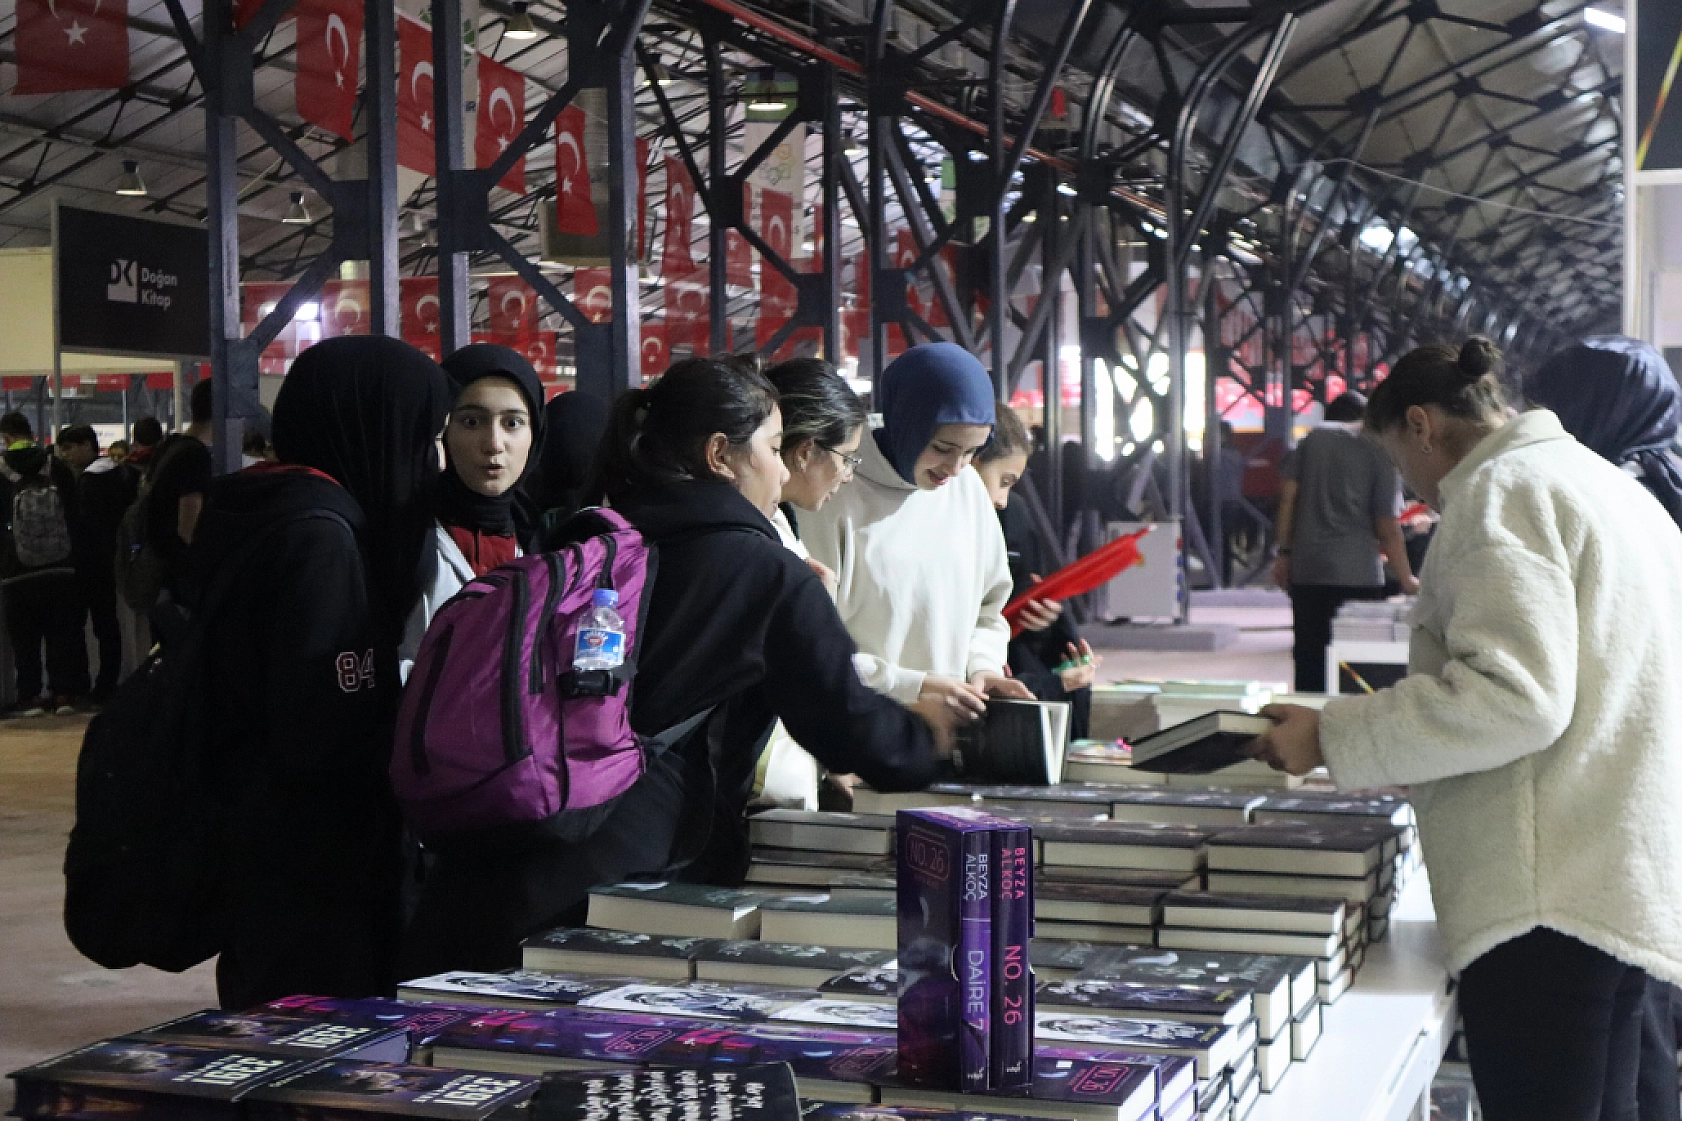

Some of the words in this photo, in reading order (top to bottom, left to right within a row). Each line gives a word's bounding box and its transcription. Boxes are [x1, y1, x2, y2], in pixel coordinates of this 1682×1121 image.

[141, 267, 178, 289] Doğan
[141, 289, 171, 311] Kitap
[335, 648, 375, 692] 84
[963, 853, 977, 901] ALKOÇ
[978, 854, 988, 900] BEYZA
[1000, 847, 1013, 900] ALKOÇ
[1014, 847, 1026, 900] BEYZA
[1004, 945, 1022, 986] NO.
[968, 1017, 984, 1030] 7
[1004, 995, 1022, 1025] 26
